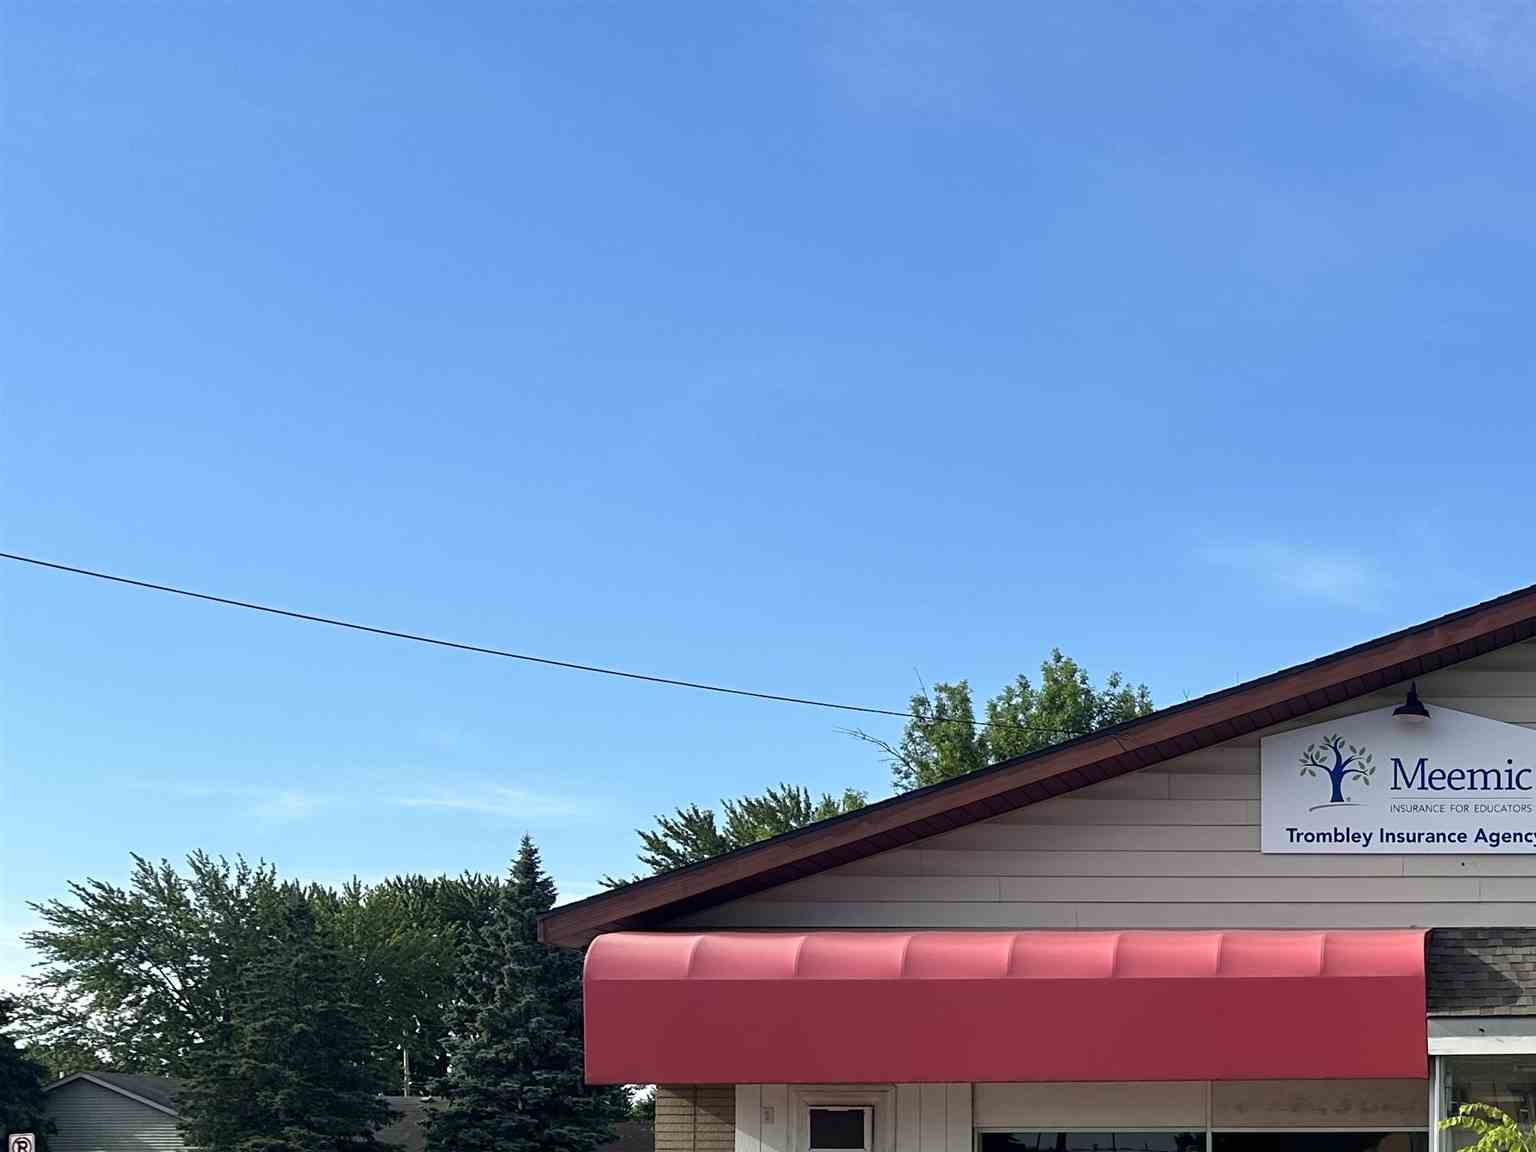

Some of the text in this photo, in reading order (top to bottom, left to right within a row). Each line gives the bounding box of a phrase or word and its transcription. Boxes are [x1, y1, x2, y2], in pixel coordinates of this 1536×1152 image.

[1390, 757, 1533, 791] Meemic
[1390, 804, 1533, 814] INSURANCE FOR EDUCATORS
[1286, 827, 1373, 847] Trombley
[1380, 827, 1467, 843] Insurance
